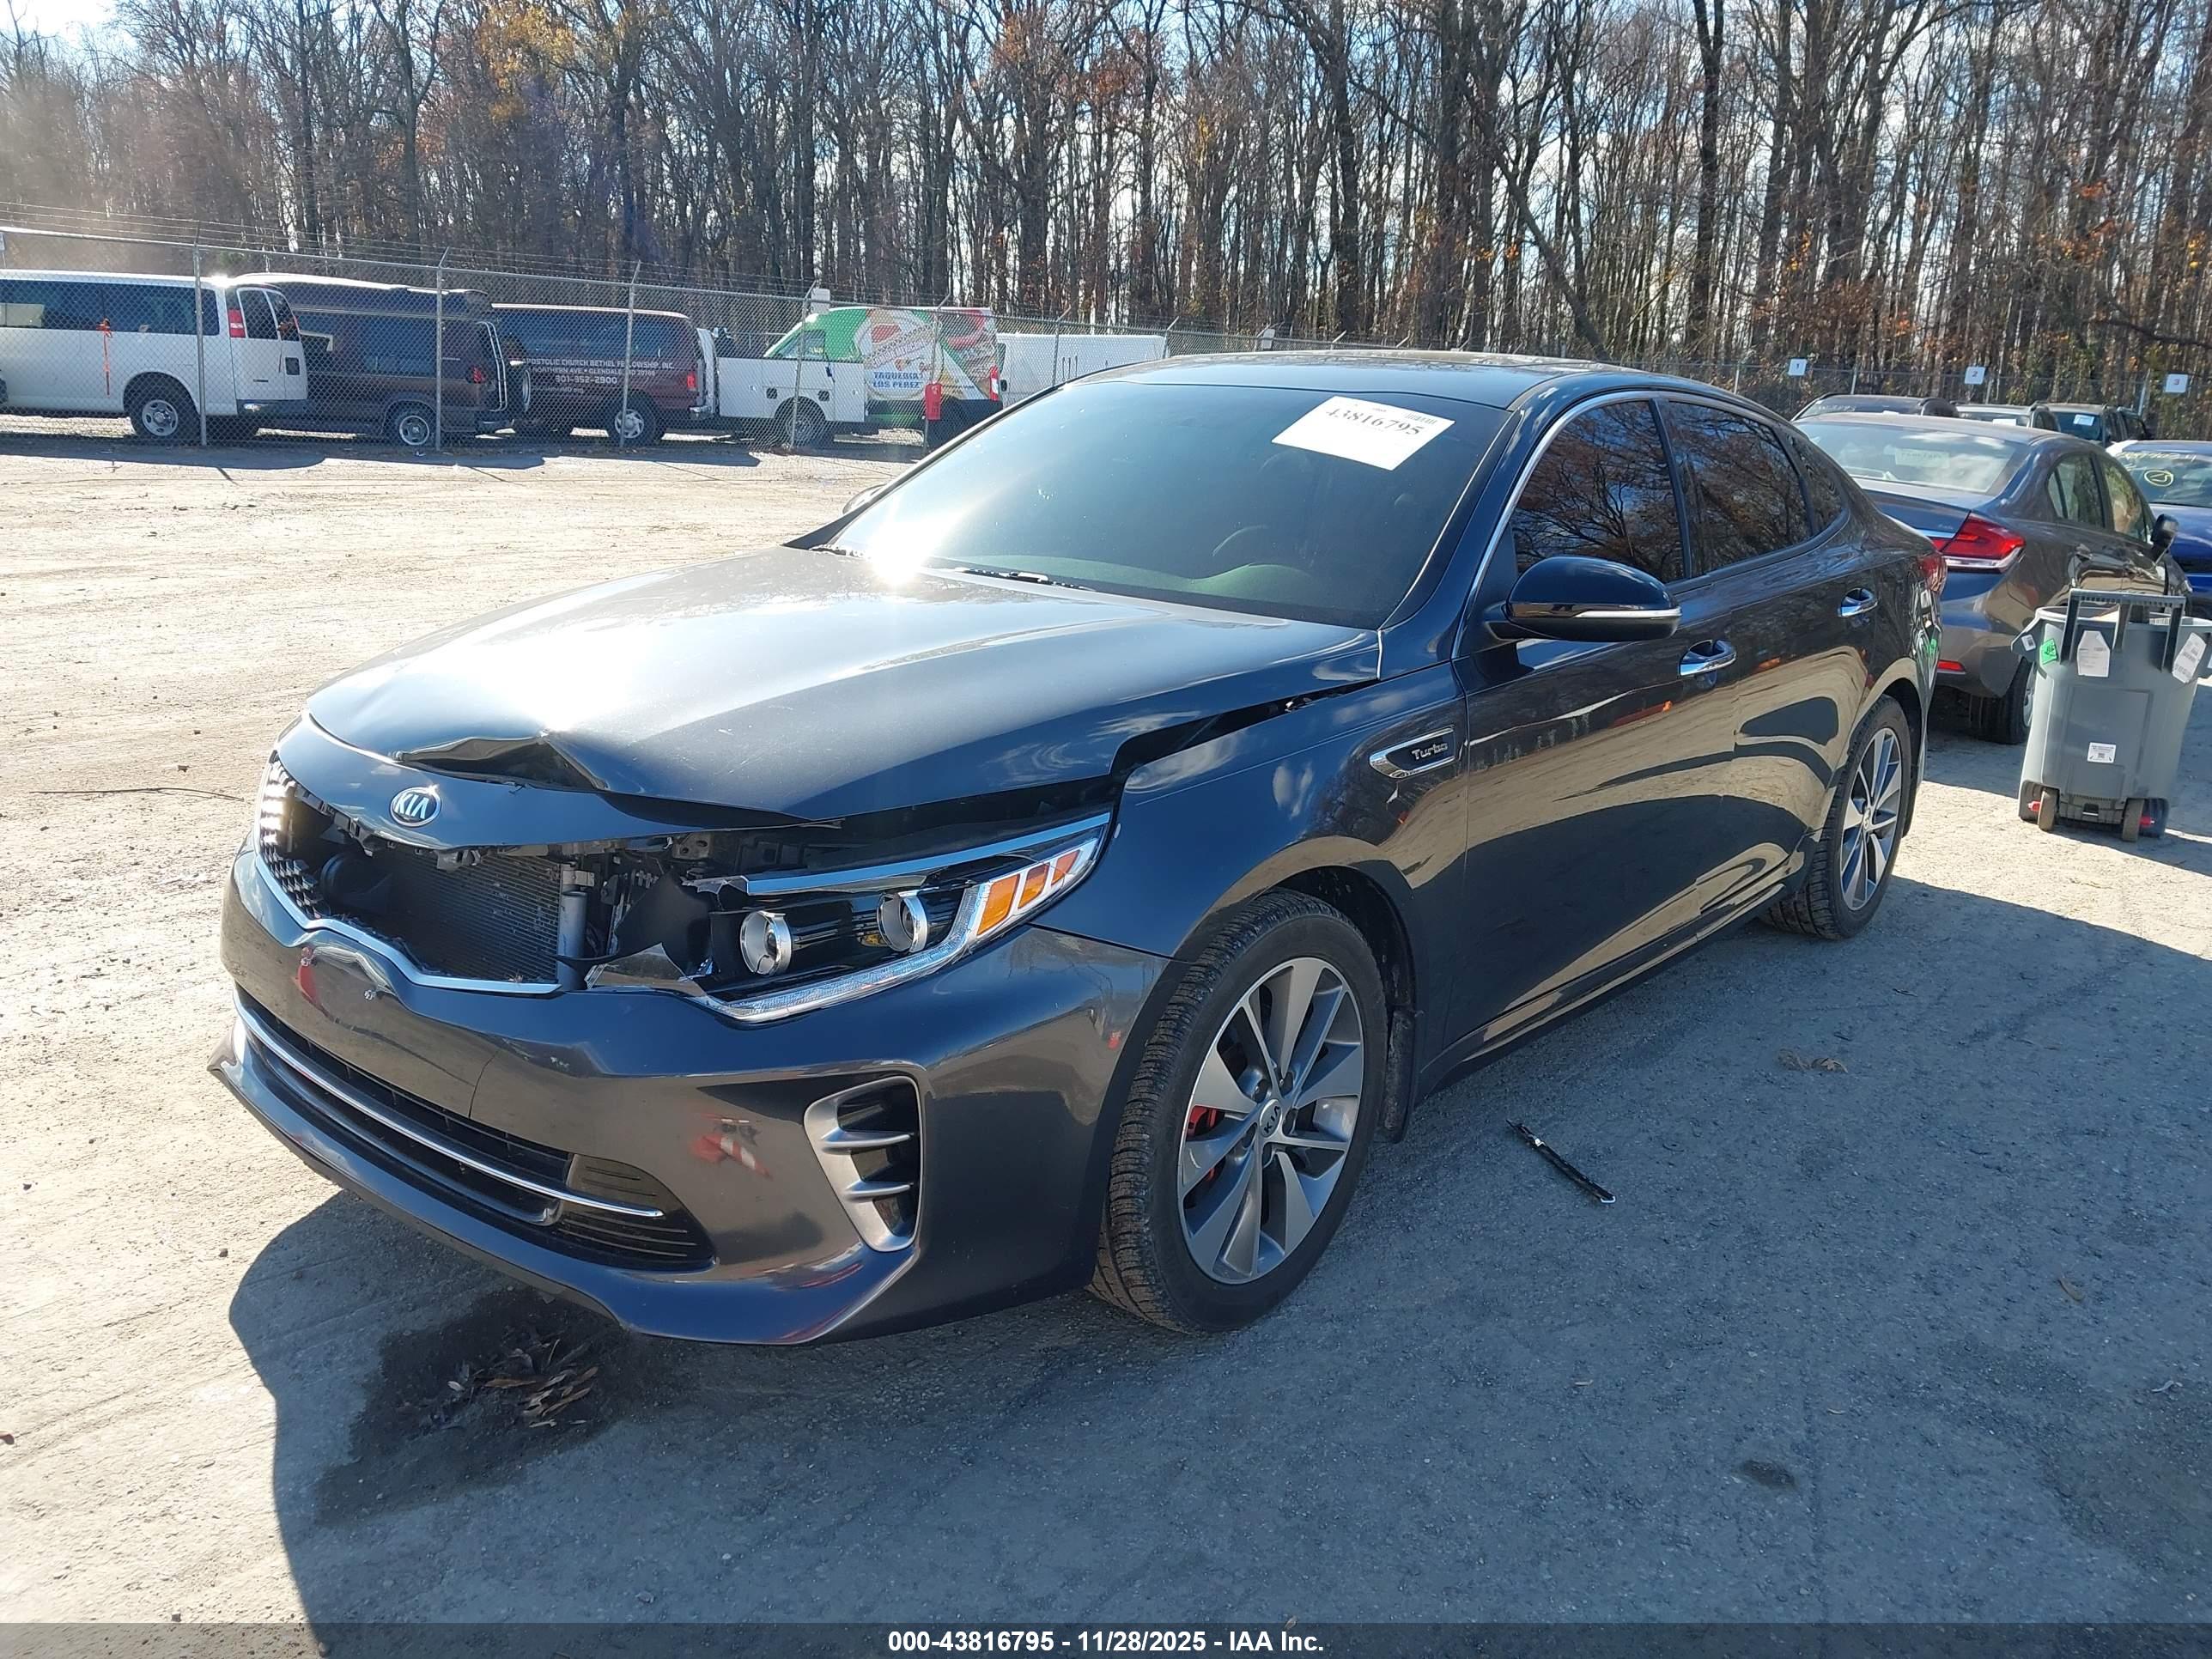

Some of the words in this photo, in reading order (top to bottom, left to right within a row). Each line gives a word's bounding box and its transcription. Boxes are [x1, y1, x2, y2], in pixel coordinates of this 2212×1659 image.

[555, 374, 617, 384] 301-352-2900
[873, 371, 919, 380] TAQUERIA
[892, 380, 921, 389] PEREZ
[1326, 408, 1425, 435] 43816795
[1411, 742, 1449, 761] Turbo
[394, 793, 430, 820] KIA
[1263, 1105, 1281, 1134] KIA
